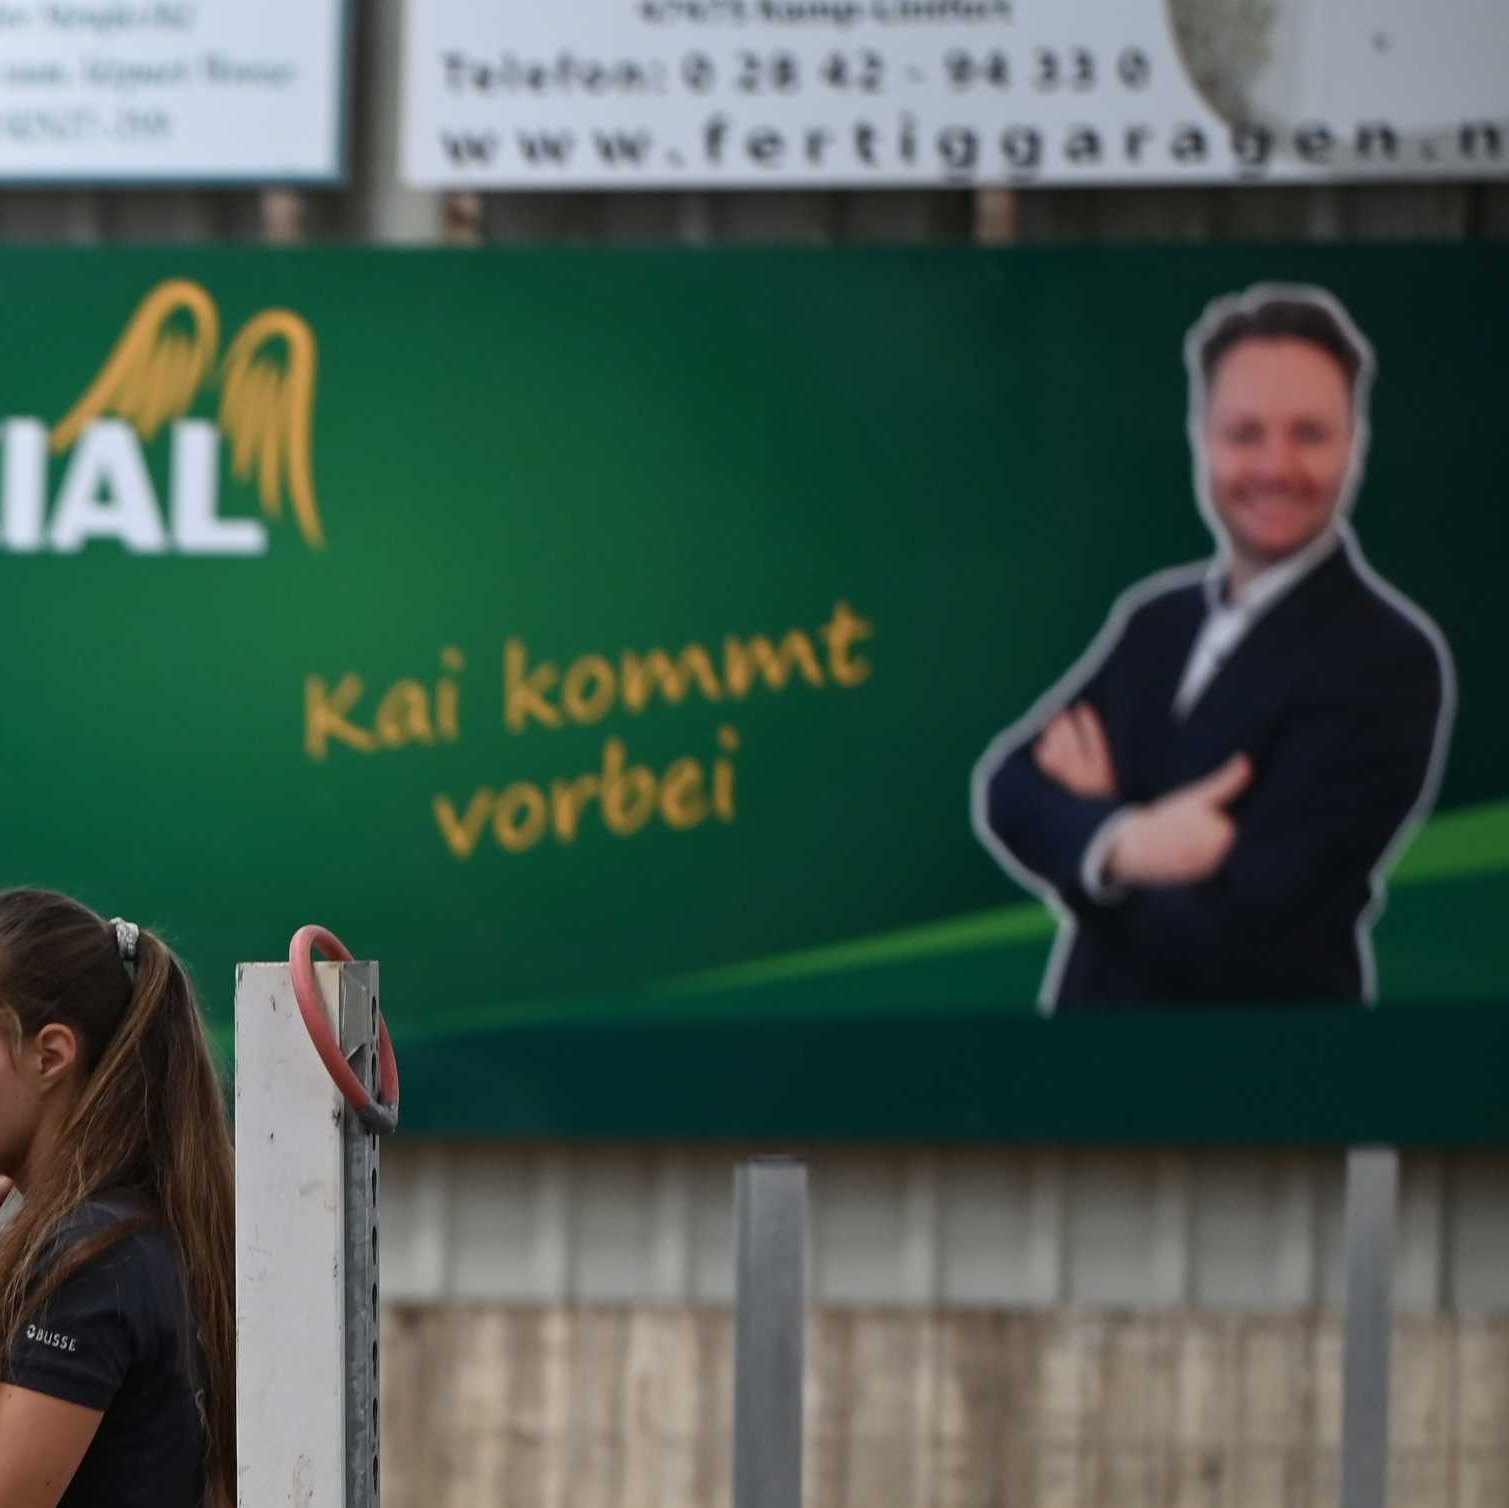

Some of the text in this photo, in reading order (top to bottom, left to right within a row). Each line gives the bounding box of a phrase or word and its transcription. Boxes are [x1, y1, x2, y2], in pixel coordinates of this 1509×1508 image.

[441, 50, 667, 94] Telefon:
[679, 50, 716, 94] 0
[1116, 46, 1152, 91] 0
[303, 597, 873, 762] Kai kommt
[431, 724, 740, 860] vorbei
